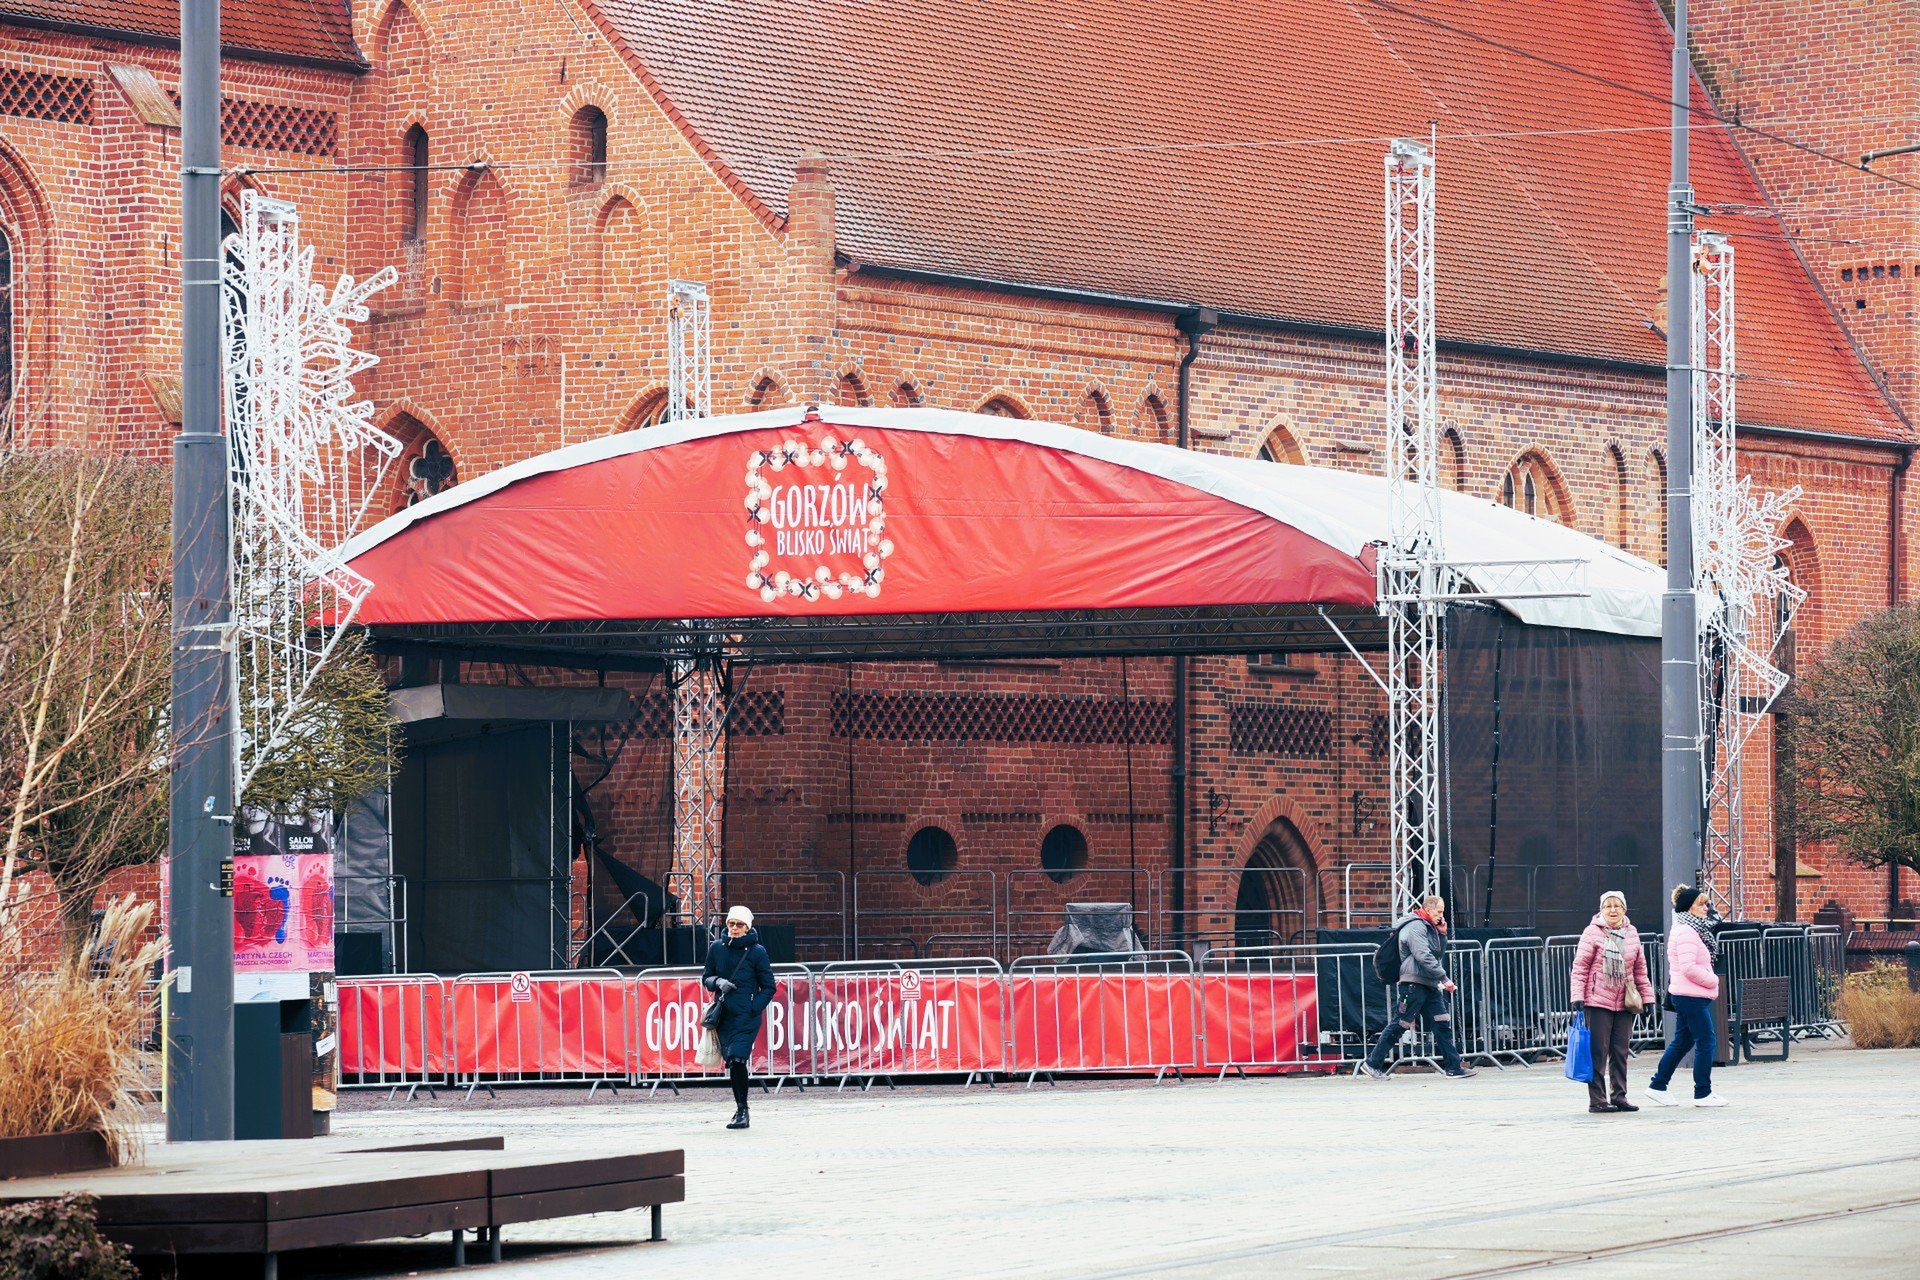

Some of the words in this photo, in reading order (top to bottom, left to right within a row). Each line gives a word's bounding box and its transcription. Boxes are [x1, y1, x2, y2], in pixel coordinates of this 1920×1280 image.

[770, 473, 869, 529] GORZÓW
[777, 529, 825, 556] BLISKO
[829, 521, 871, 558] ŚWIĄT
[288, 836, 314, 845] SALON
[268, 951, 293, 959] CZECH
[646, 1001, 753, 1052] GOR
[770, 1001, 863, 1051] BLISKO
[873, 987, 955, 1059] ŚWIĄT
